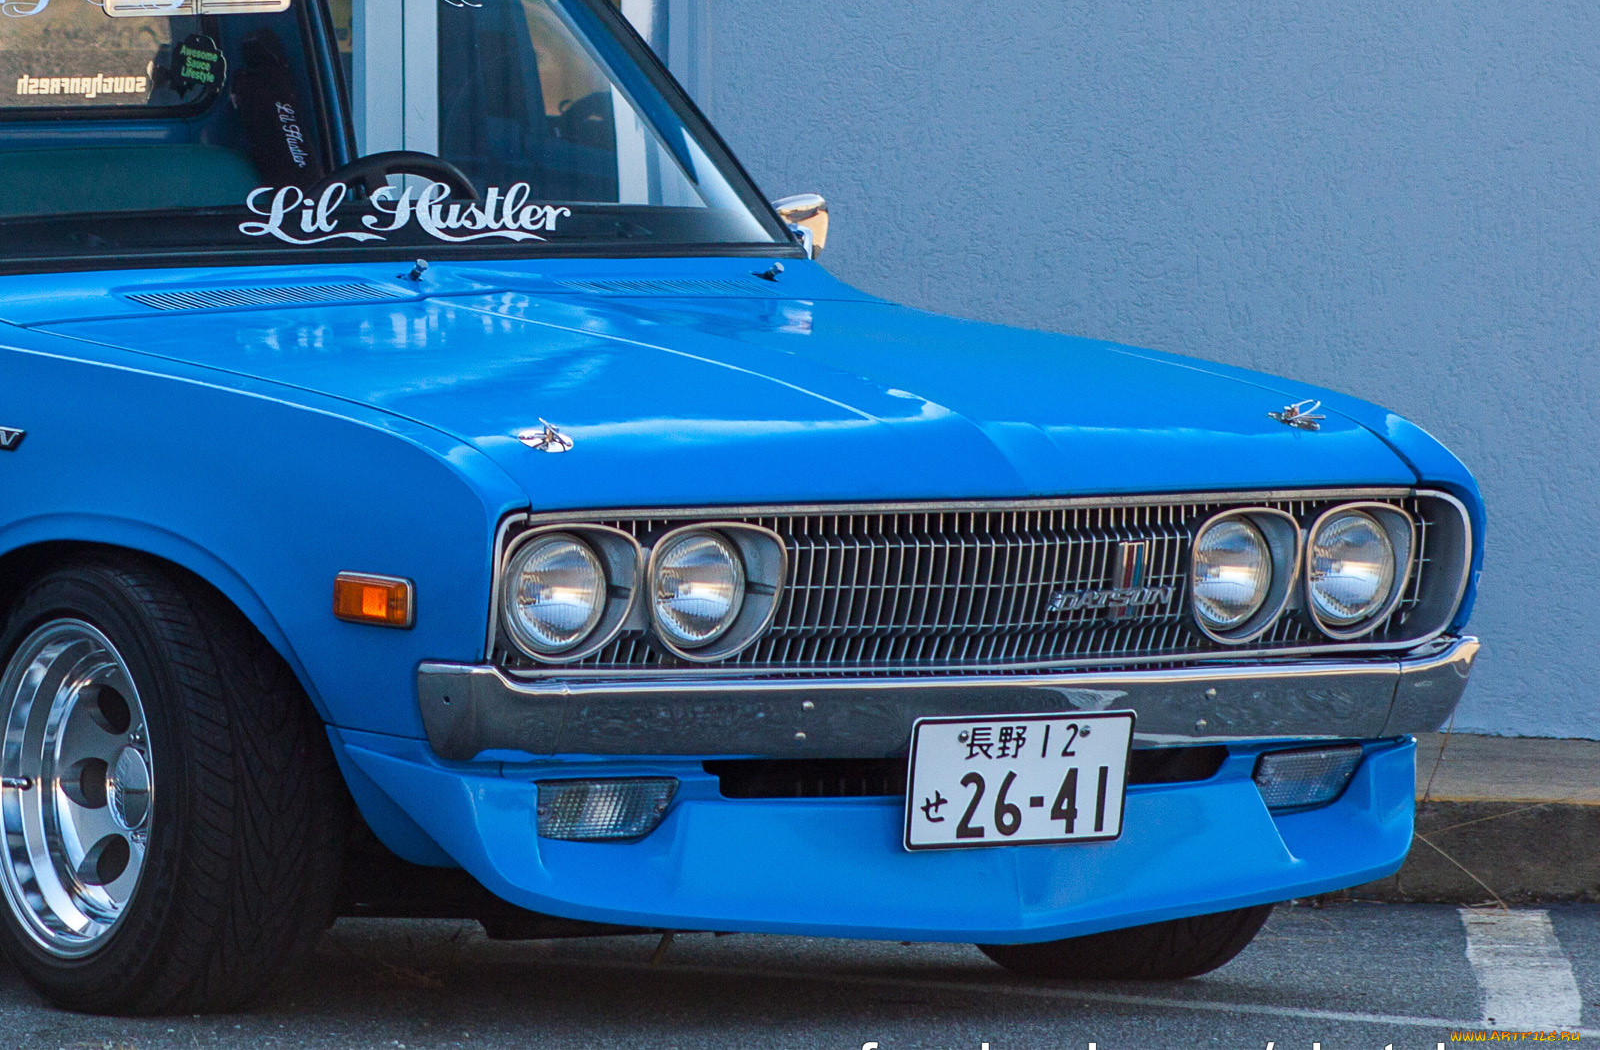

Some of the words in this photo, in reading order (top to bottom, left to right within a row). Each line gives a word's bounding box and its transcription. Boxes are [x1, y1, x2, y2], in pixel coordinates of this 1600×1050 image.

[180, 45, 219, 62] Awesome
[186, 56, 211, 71] Sauce
[238, 182, 387, 245] Lil
[363, 182, 571, 242] Hustler
[1049, 584, 1176, 611] DATSUN
[965, 725, 1027, 760] 長野
[1041, 723, 1079, 758] 12
[921, 790, 948, 823] せ
[956, 766, 1109, 839] 26-41
